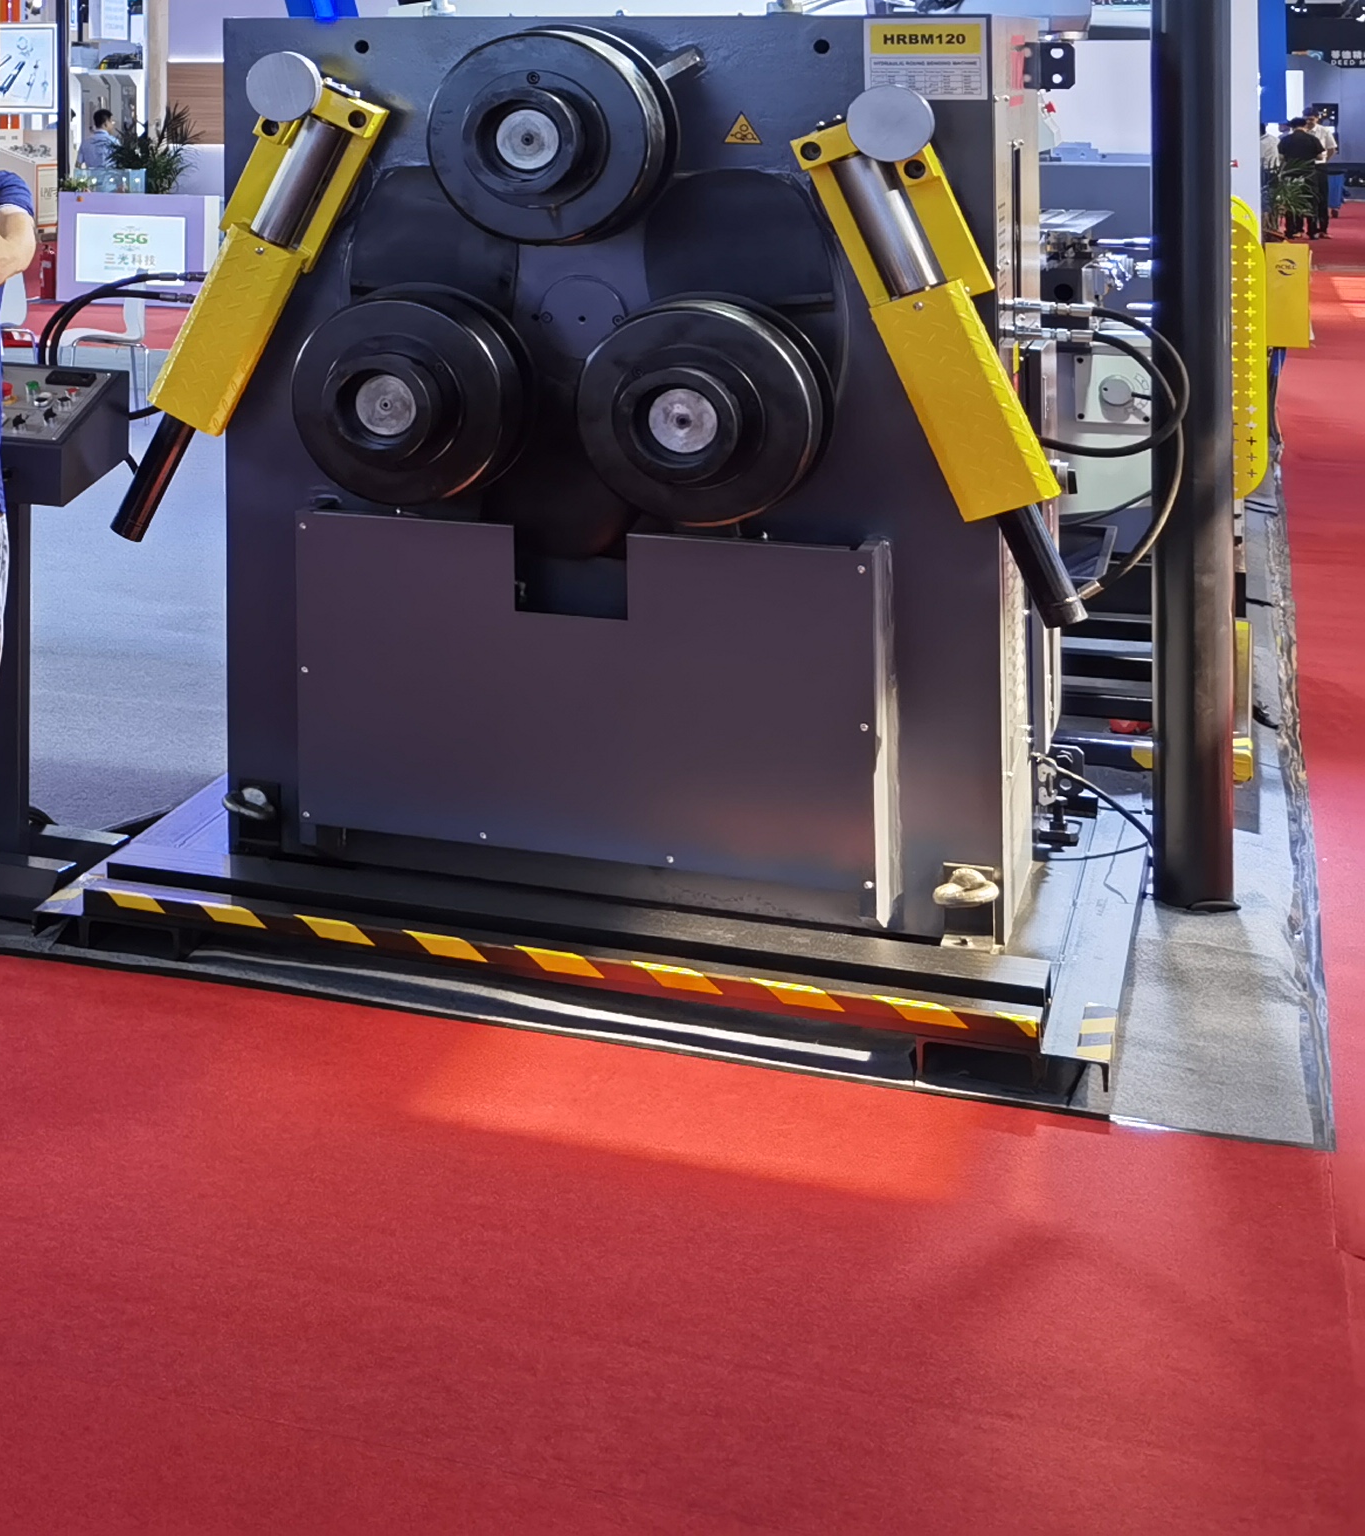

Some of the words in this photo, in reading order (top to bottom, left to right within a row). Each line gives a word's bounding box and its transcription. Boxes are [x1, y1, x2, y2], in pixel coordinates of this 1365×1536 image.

[883, 33, 966, 45] HRBM120
[112, 232, 149, 244] SSG
[104, 252, 156, 266] 三光科技
